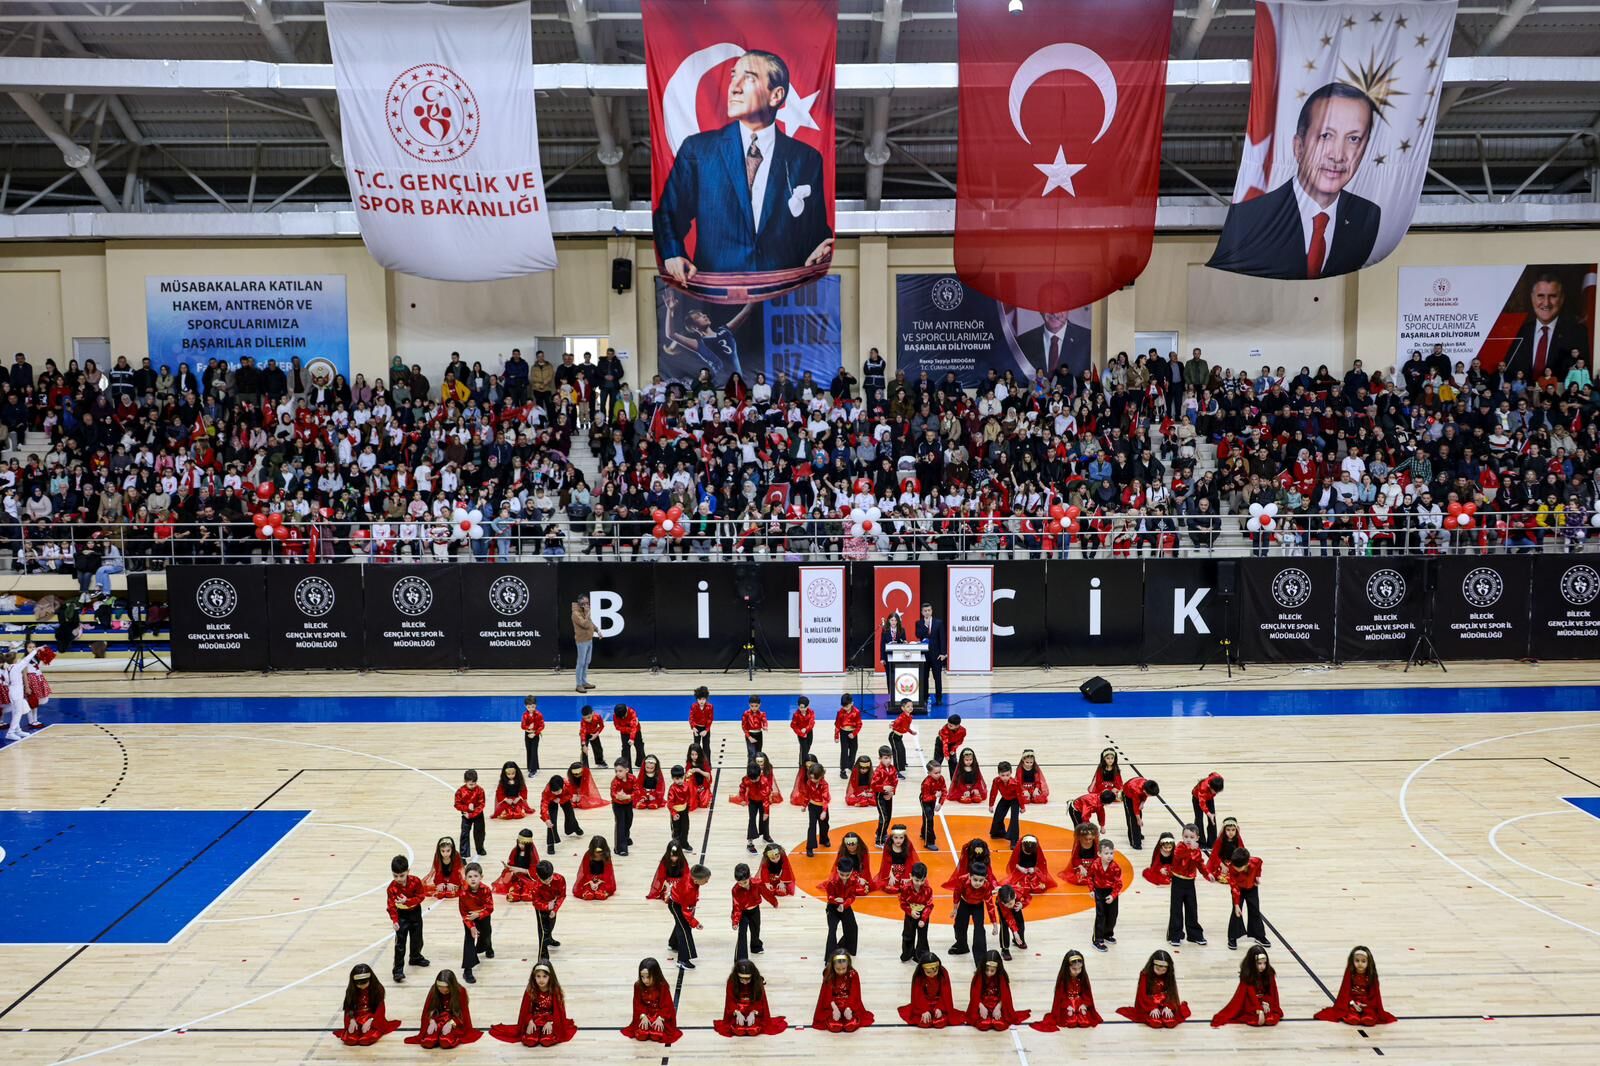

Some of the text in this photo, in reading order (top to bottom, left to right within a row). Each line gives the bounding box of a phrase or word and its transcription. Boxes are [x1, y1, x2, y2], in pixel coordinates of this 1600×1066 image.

[355, 169, 535, 195] T.C. GENÇLİK VE
[358, 195, 539, 217] SPOR BAKANLIĞI
[160, 280, 323, 292] MÜSABAKALARA KATILAN
[173, 298, 312, 312] HAKEM, ANTRENÖR VE
[1404, 313, 1421, 321] TÜM
[1424, 313, 1468, 321] ANTRENÖR
[187, 318, 299, 330] SPORCULARIMIZA
[912, 319, 984, 330] TÜM ANTRENÖR
[1405, 322, 1475, 330] SPORCULARIMIZA
[902, 333, 994, 342] VE SPORCULARIMIZA
[182, 336, 306, 351] BAŞARILAR DİLERİM
[905, 342, 991, 352] BAŞARILAR DİLİYORUM
[1261, 623, 1286, 631] GENÇLİK
[1356, 624, 1382, 632] GENÇLİK
[1548, 620, 1575, 628] GENÇLİK
[188, 633, 216, 641] GENÇLİK
[286, 632, 313, 640] GENÇLİK
[384, 631, 411, 639] GENÇLİK
[480, 630, 506, 638] GENÇLİK
[1366, 633, 1406, 641] MÜDÜRLÜĞÜ
[1460, 631, 1502, 639] MÜDÜRLÜĞÜ
[394, 639, 435, 647] MÜDÜRLÜĞÜ
